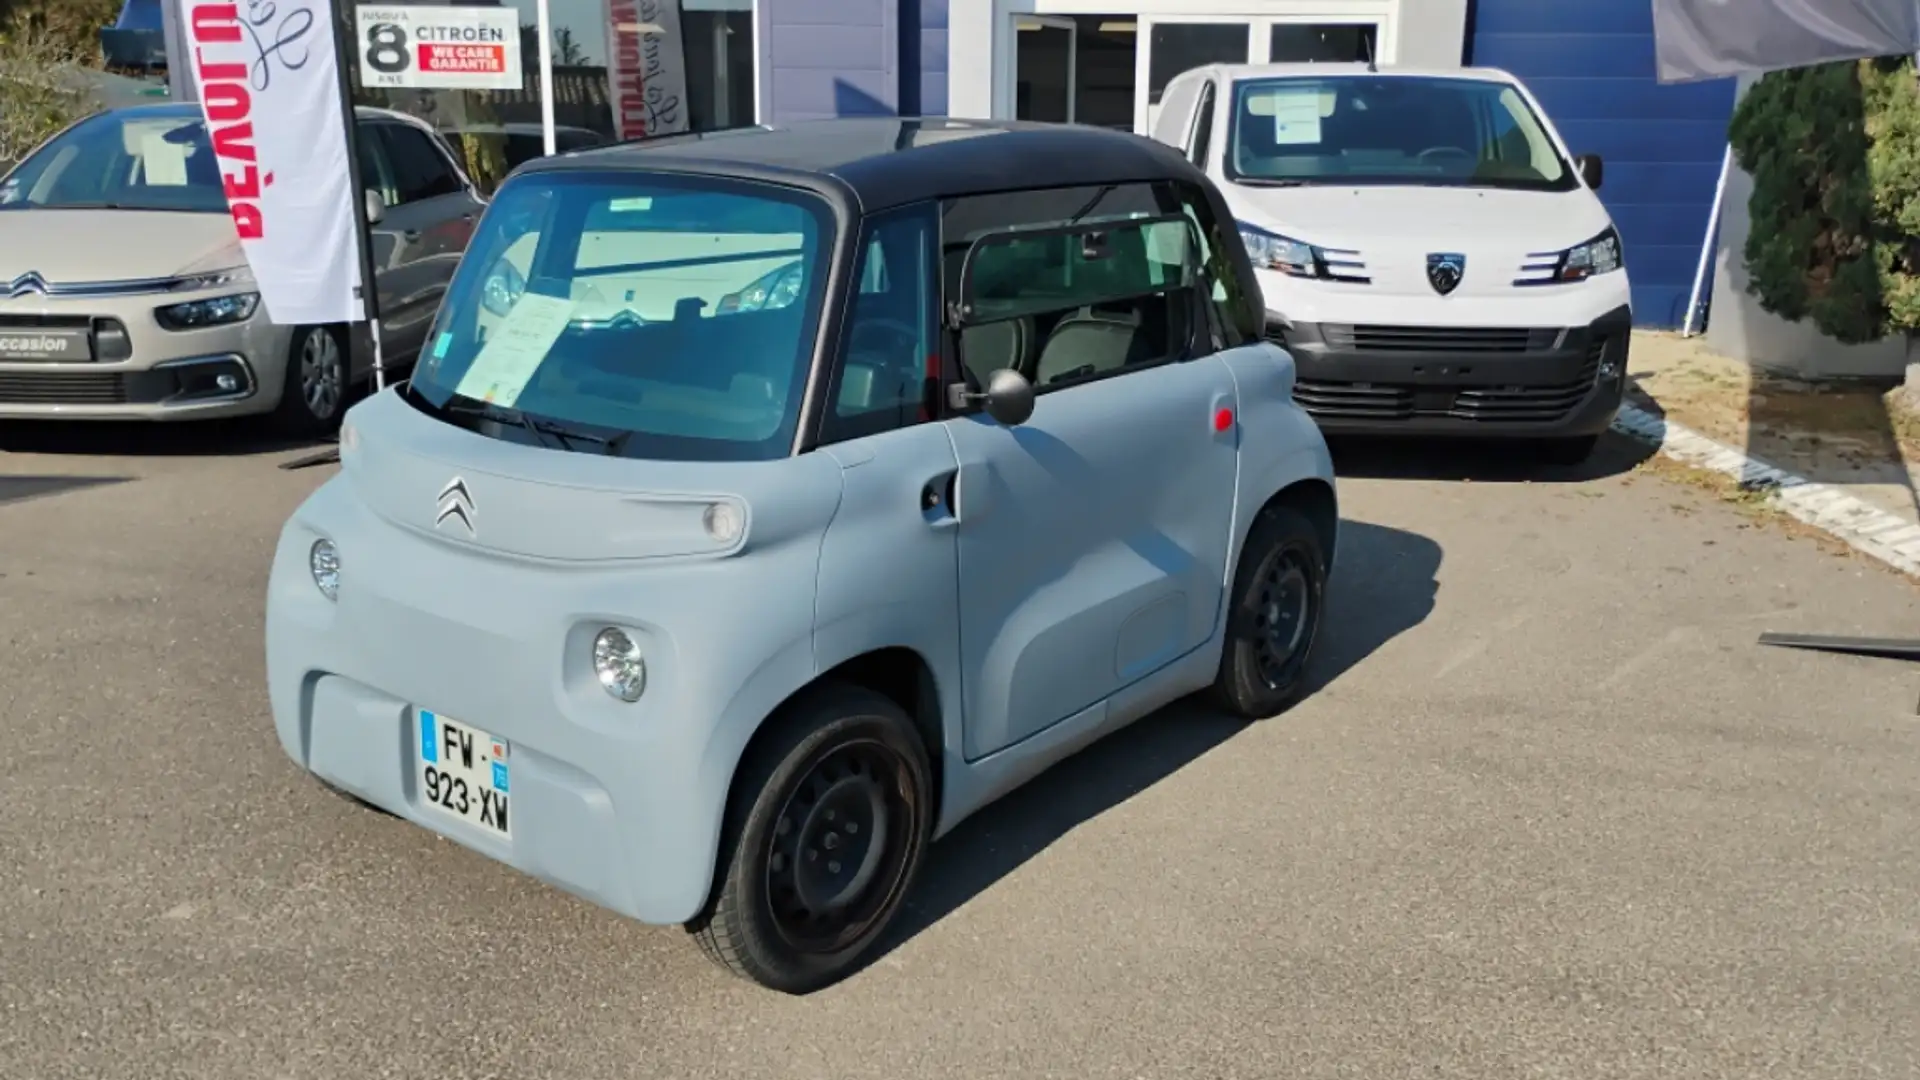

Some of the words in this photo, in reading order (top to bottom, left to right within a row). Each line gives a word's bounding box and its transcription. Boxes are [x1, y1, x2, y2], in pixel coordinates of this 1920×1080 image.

[416, 22, 504, 41] CITROËN
[366, 23, 411, 73] 8
[431, 46, 454, 58] WE
[456, 46, 494, 58] CARE
[429, 58, 500, 71] GARANTIE
[425, 765, 508, 833] 923-XW
